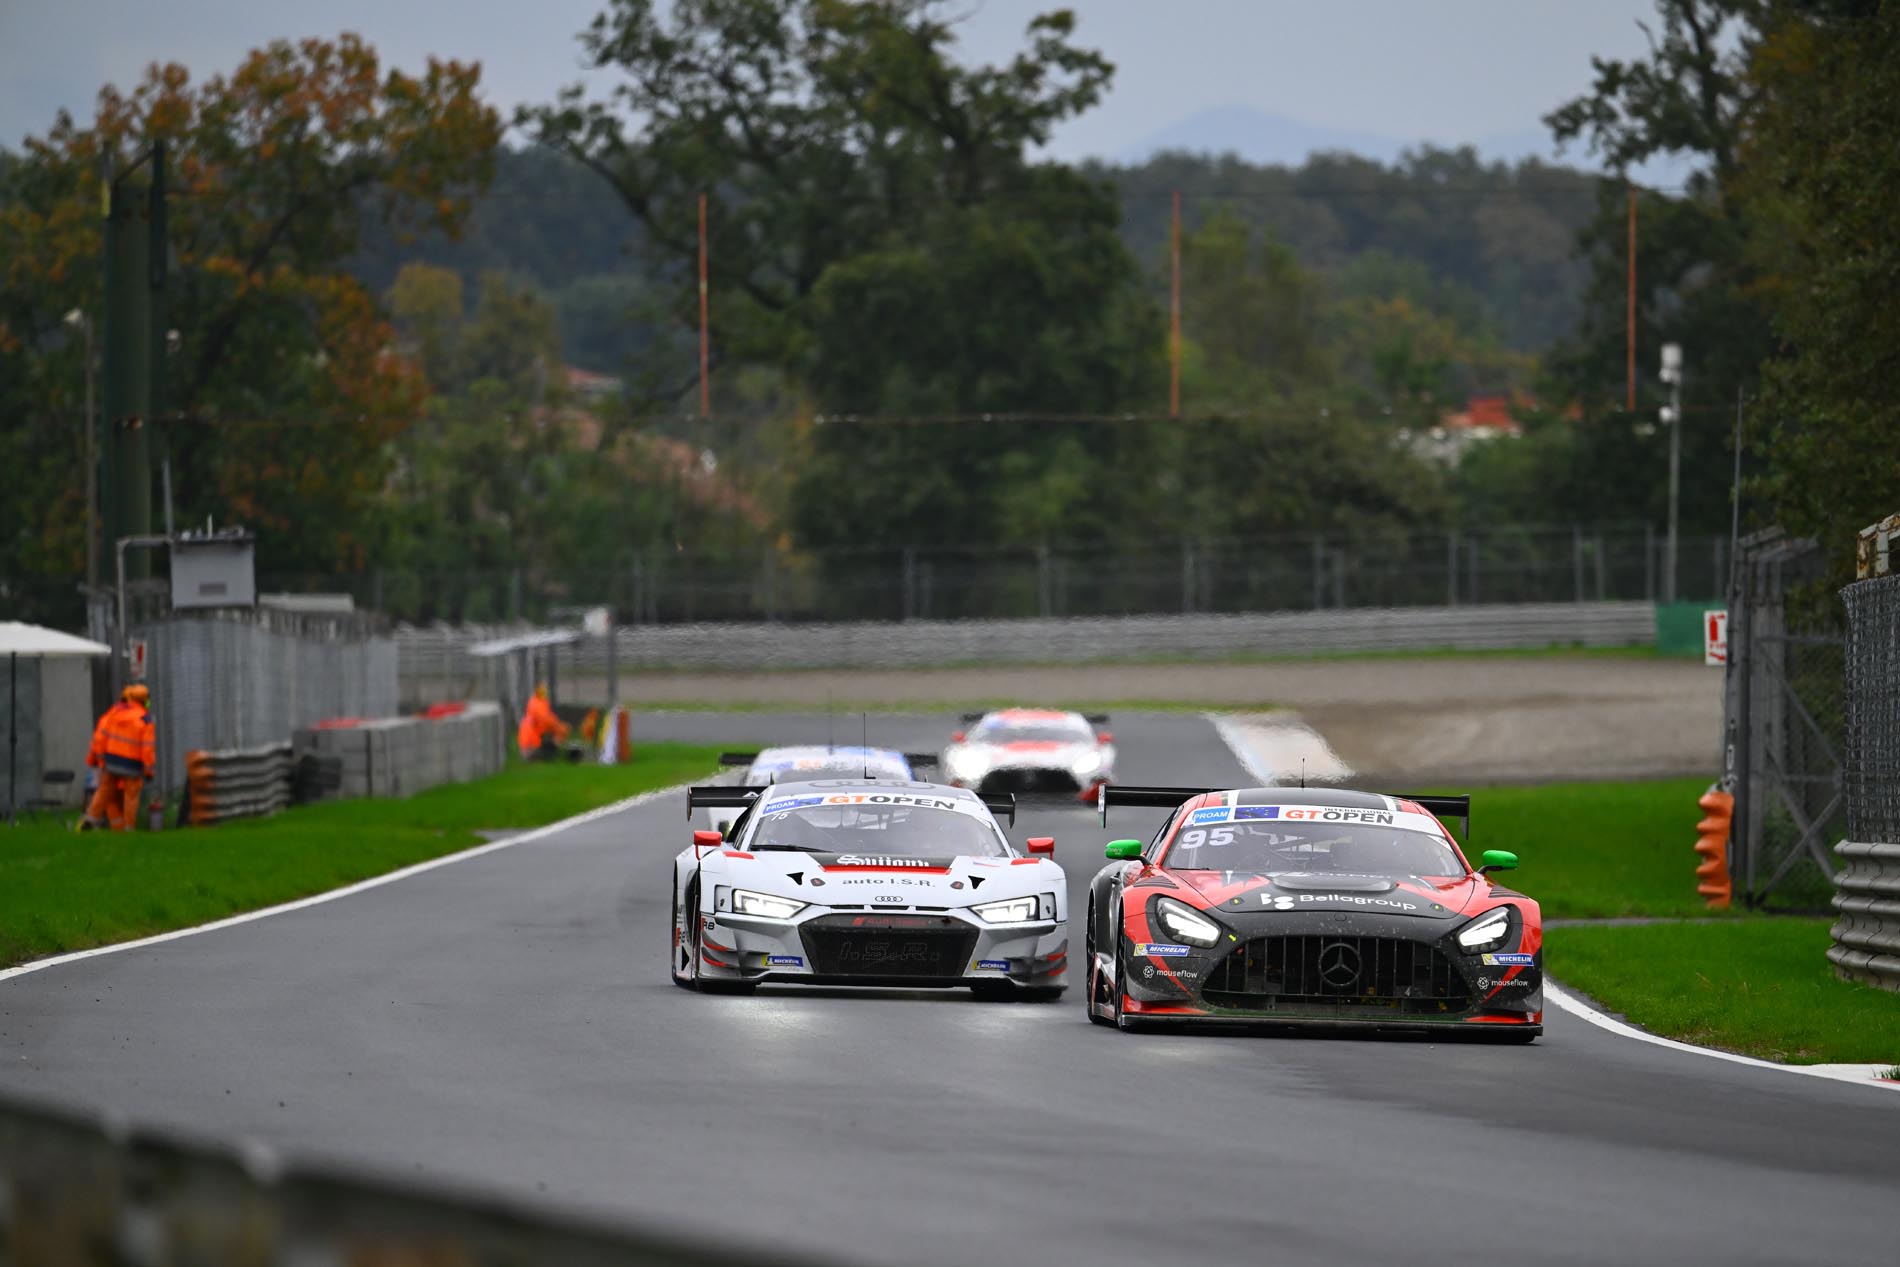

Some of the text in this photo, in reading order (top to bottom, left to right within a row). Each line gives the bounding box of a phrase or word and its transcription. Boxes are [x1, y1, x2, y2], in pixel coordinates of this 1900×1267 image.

[766, 801, 795, 811] PROAM
[1324, 807, 1392, 815] INTERNATIONAL
[1194, 810, 1229, 820] PROAM
[1181, 826, 1235, 849] 95
[1300, 895, 1417, 910] Bellagroup
[772, 957, 800, 965] MICHELIN
[1156, 969, 1198, 978] mouseflow
